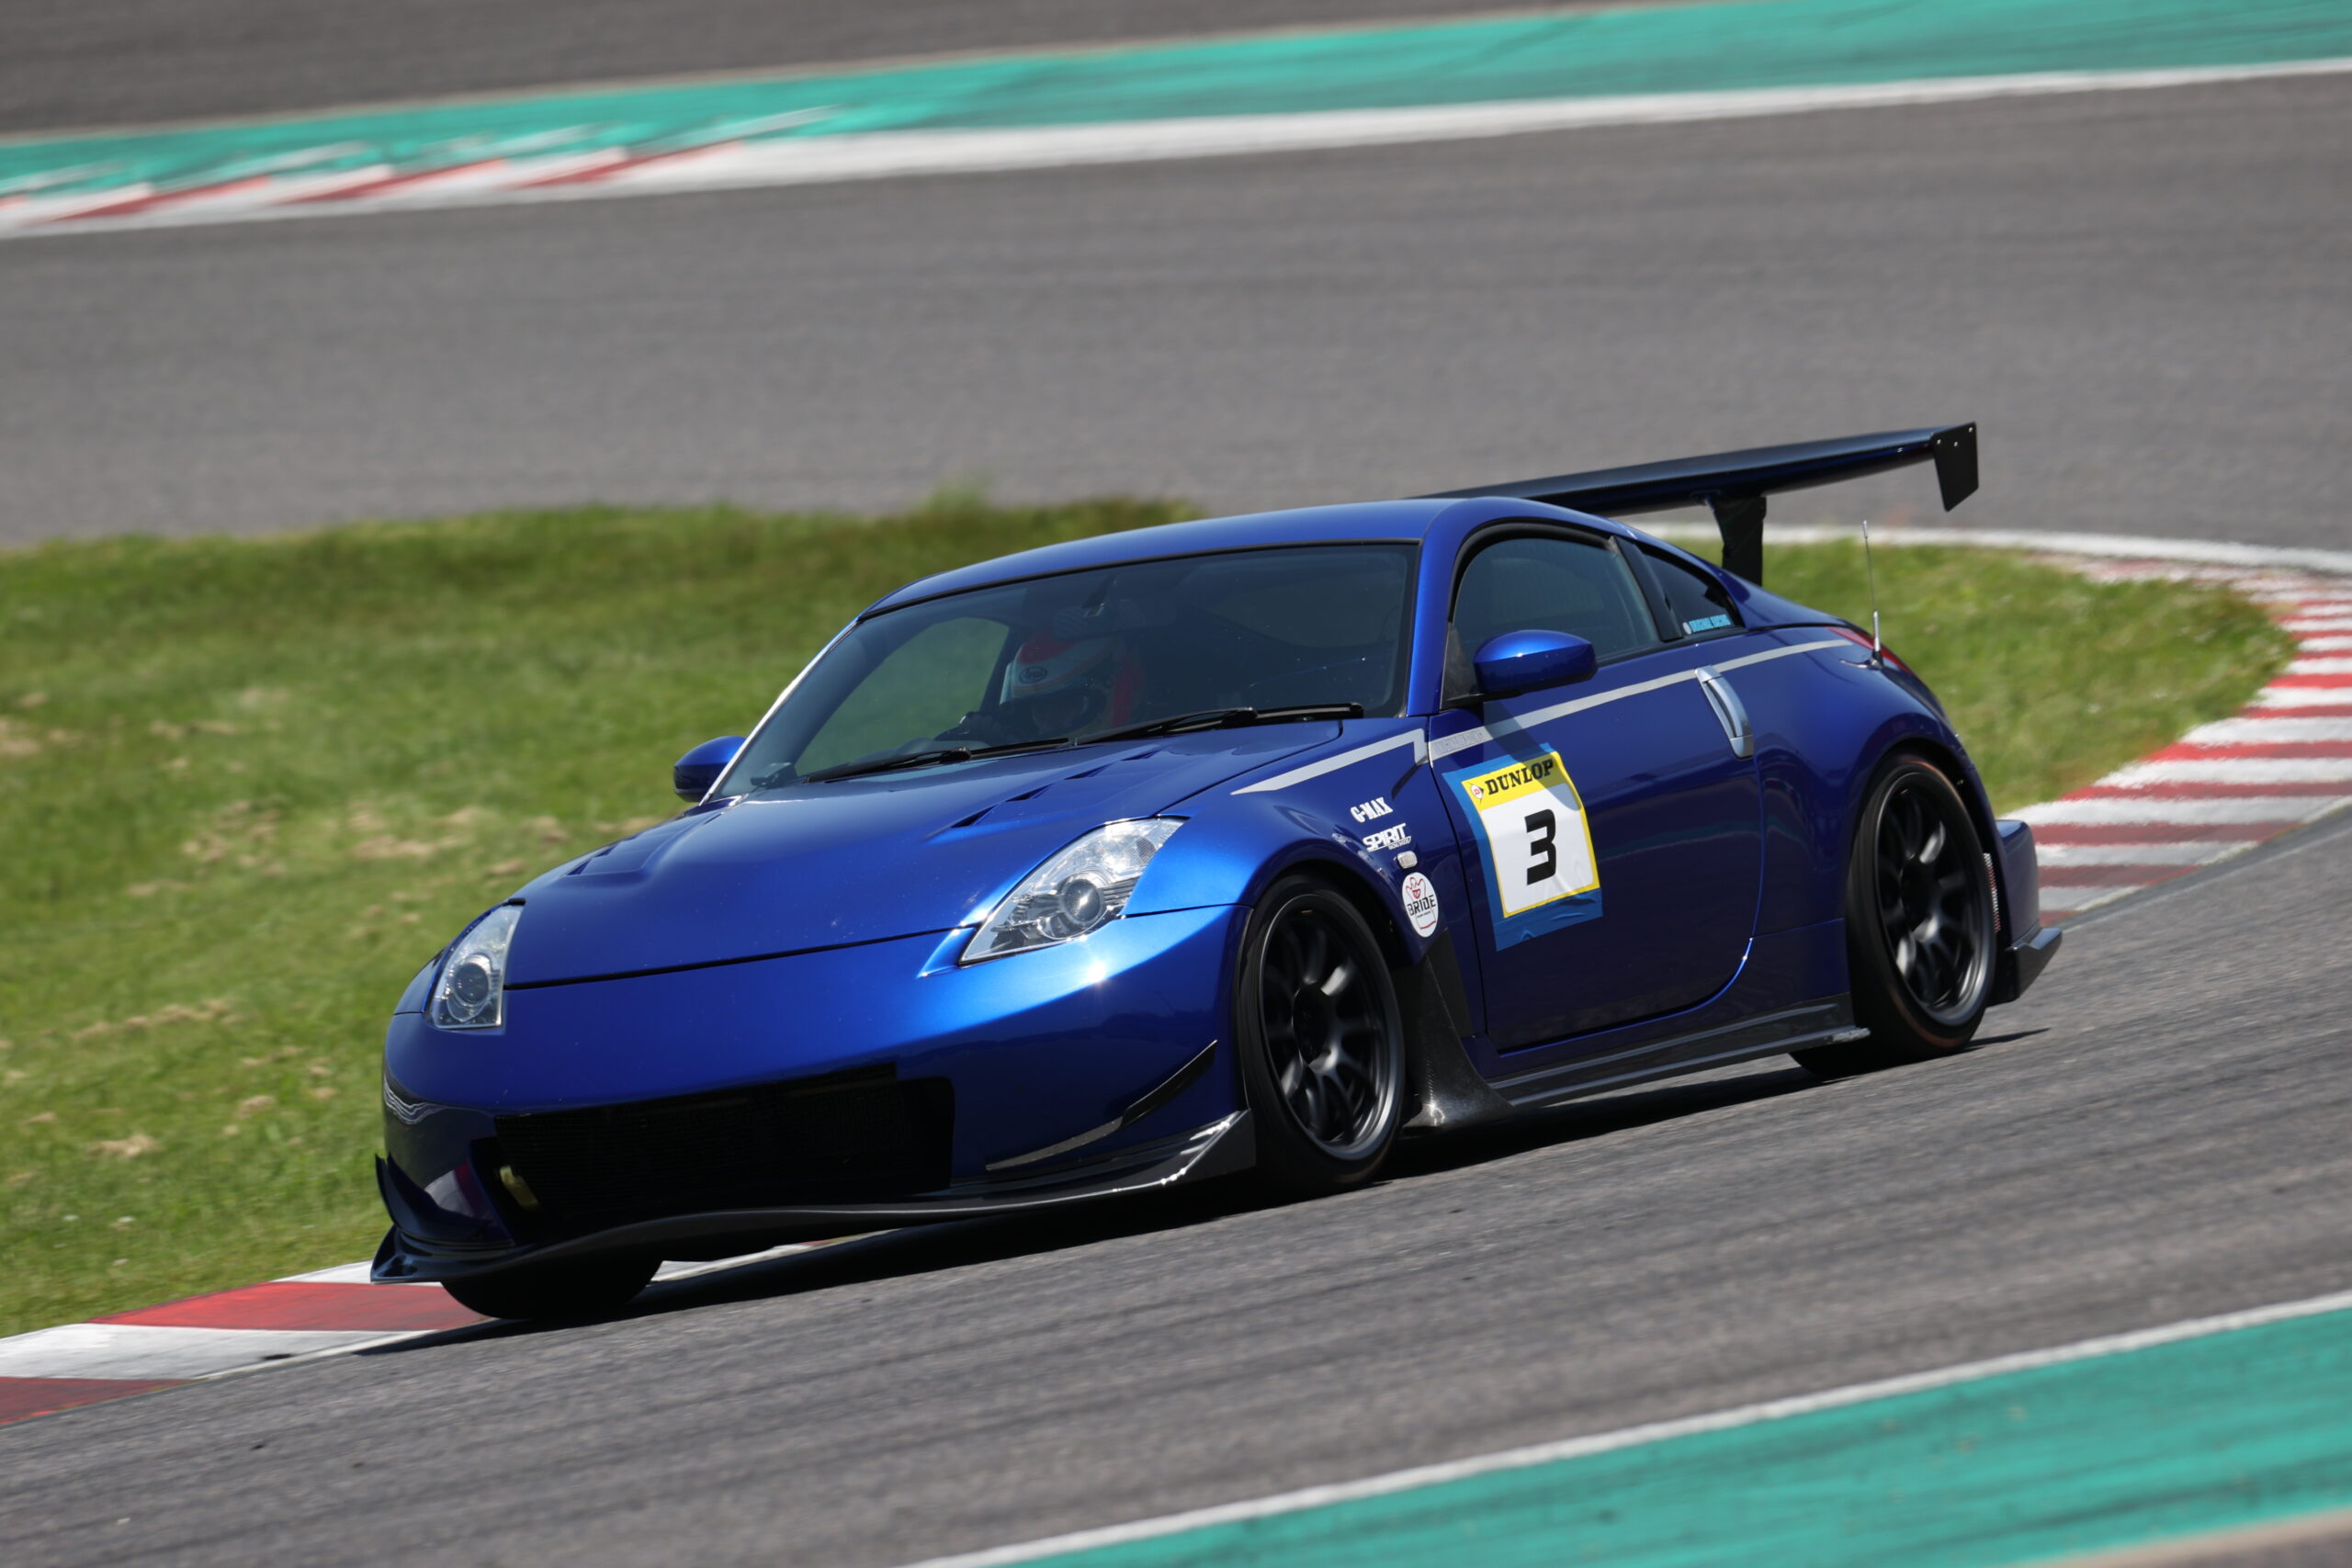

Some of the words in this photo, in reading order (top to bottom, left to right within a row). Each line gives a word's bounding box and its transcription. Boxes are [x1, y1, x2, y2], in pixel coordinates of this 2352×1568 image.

[1485, 759, 1554, 795] DUNLOP
[1363, 822, 1407, 852] SPIRIT
[1524, 808, 1556, 886] 3
[1407, 895, 1436, 916] BRIDE
